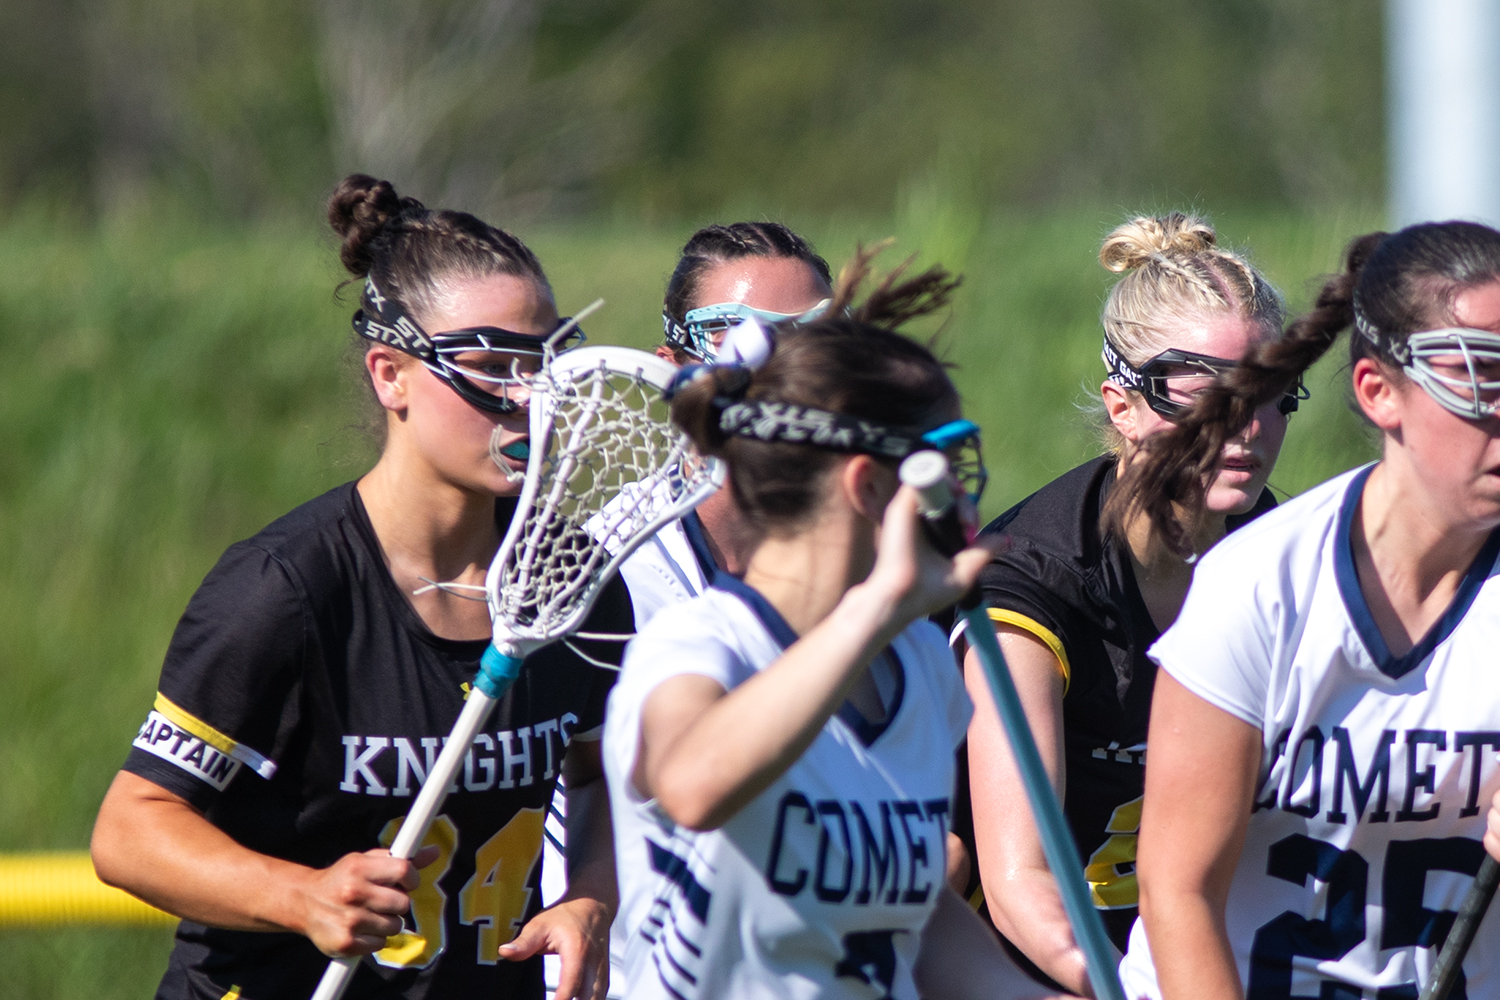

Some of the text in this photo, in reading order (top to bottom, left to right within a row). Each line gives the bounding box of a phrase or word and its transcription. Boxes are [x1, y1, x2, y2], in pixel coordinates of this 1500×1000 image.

[365, 319, 408, 349] STX
[138, 718, 236, 784] APTAIN
[371, 803, 546, 970] 34
